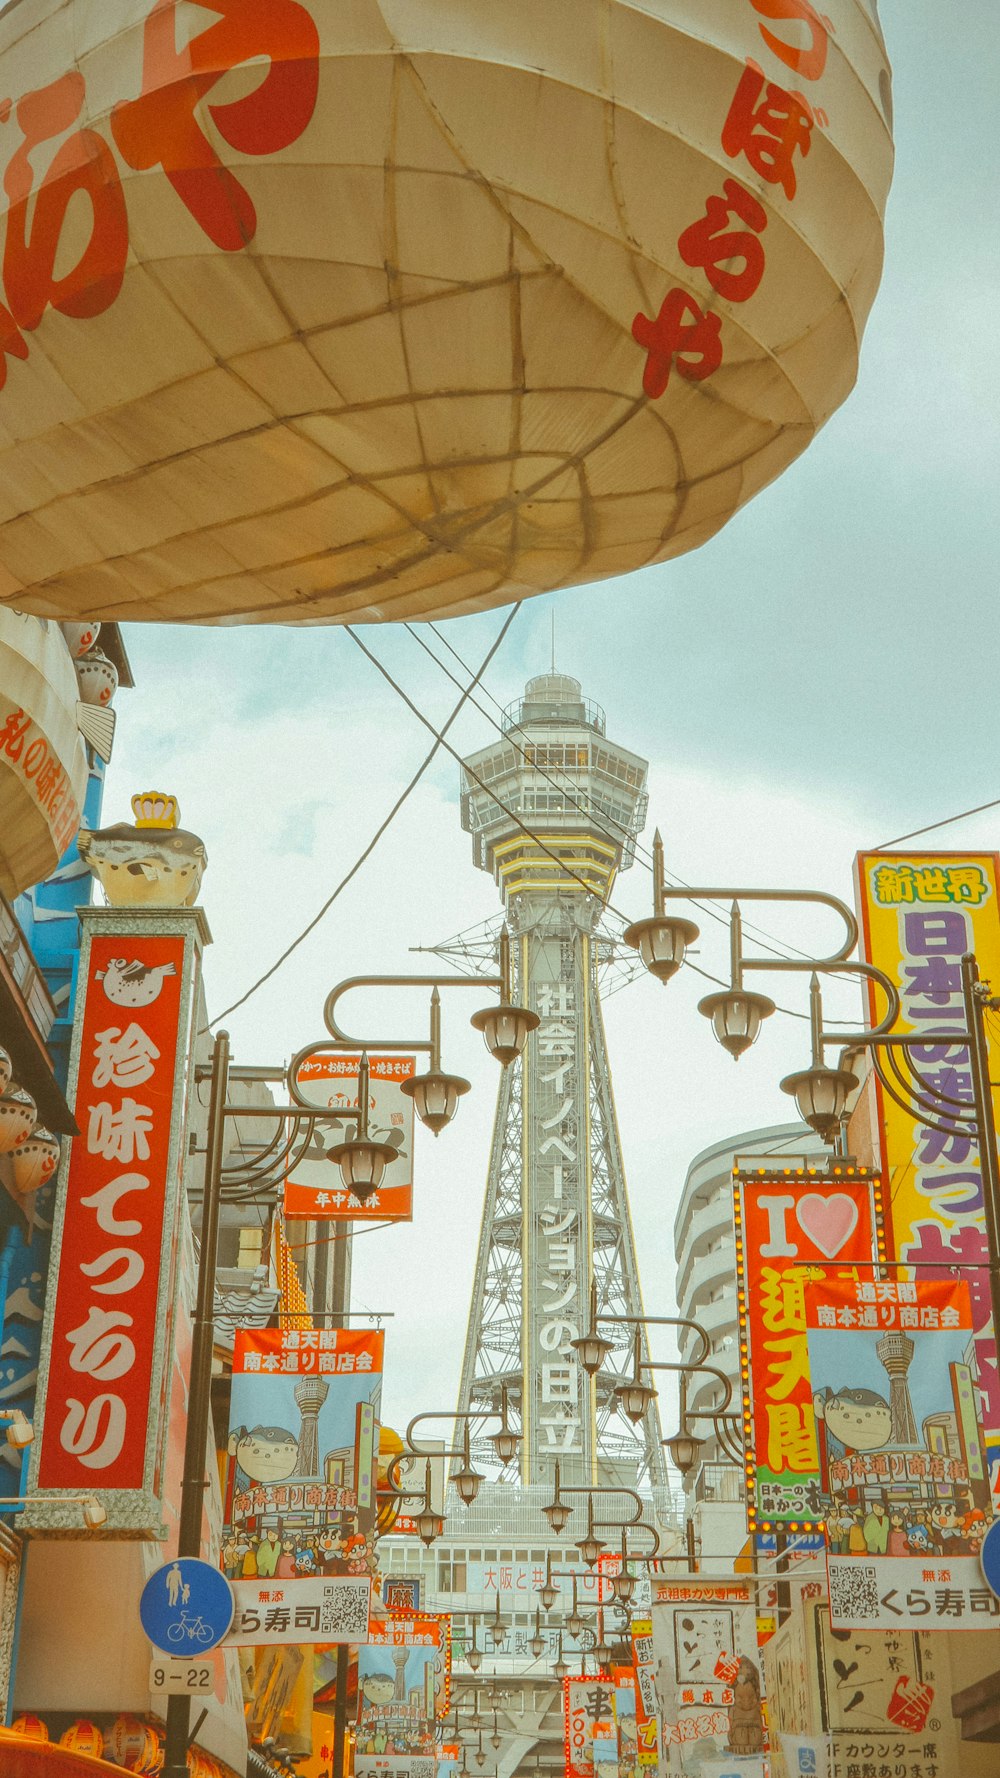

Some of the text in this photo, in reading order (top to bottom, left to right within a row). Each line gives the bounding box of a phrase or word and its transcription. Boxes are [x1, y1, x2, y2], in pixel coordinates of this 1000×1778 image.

[875, 867, 987, 903] 新世界
[299, 1061, 412, 1075] かつ・お好み・焼きそば
[903, 911, 987, 1213] 日本一の串かつ
[315, 1192, 380, 1209] 年中無休
[536, 983, 582, 1454] 社会イノベーションの日立
[756, 1194, 798, 1258] I
[59, 1021, 161, 1470] 珍味てっちり
[856, 1282, 917, 1303] 通天閣
[816, 1304, 960, 1329] 南本通り商店会
[281, 1331, 338, 1350] 通天閣
[243, 1351, 374, 1372] 南本通り商店会
[832, 1453, 968, 1481] 南本通り商店街
[235, 1486, 357, 1511] 南本通り商店街
[761, 1484, 804, 1496] 日本一の
[762, 1498, 804, 1513] 串かつ
[922, 1569, 951, 1582] 無添
[258, 1590, 284, 1602] 無添
[881, 1588, 1000, 1617] くら寿司
[230, 1606, 321, 1633] ら寿司
[484, 1631, 562, 1655] 日立製所
[846, 1744, 937, 1758] カウンター席
[846, 1764, 939, 1778] 座敷あります
